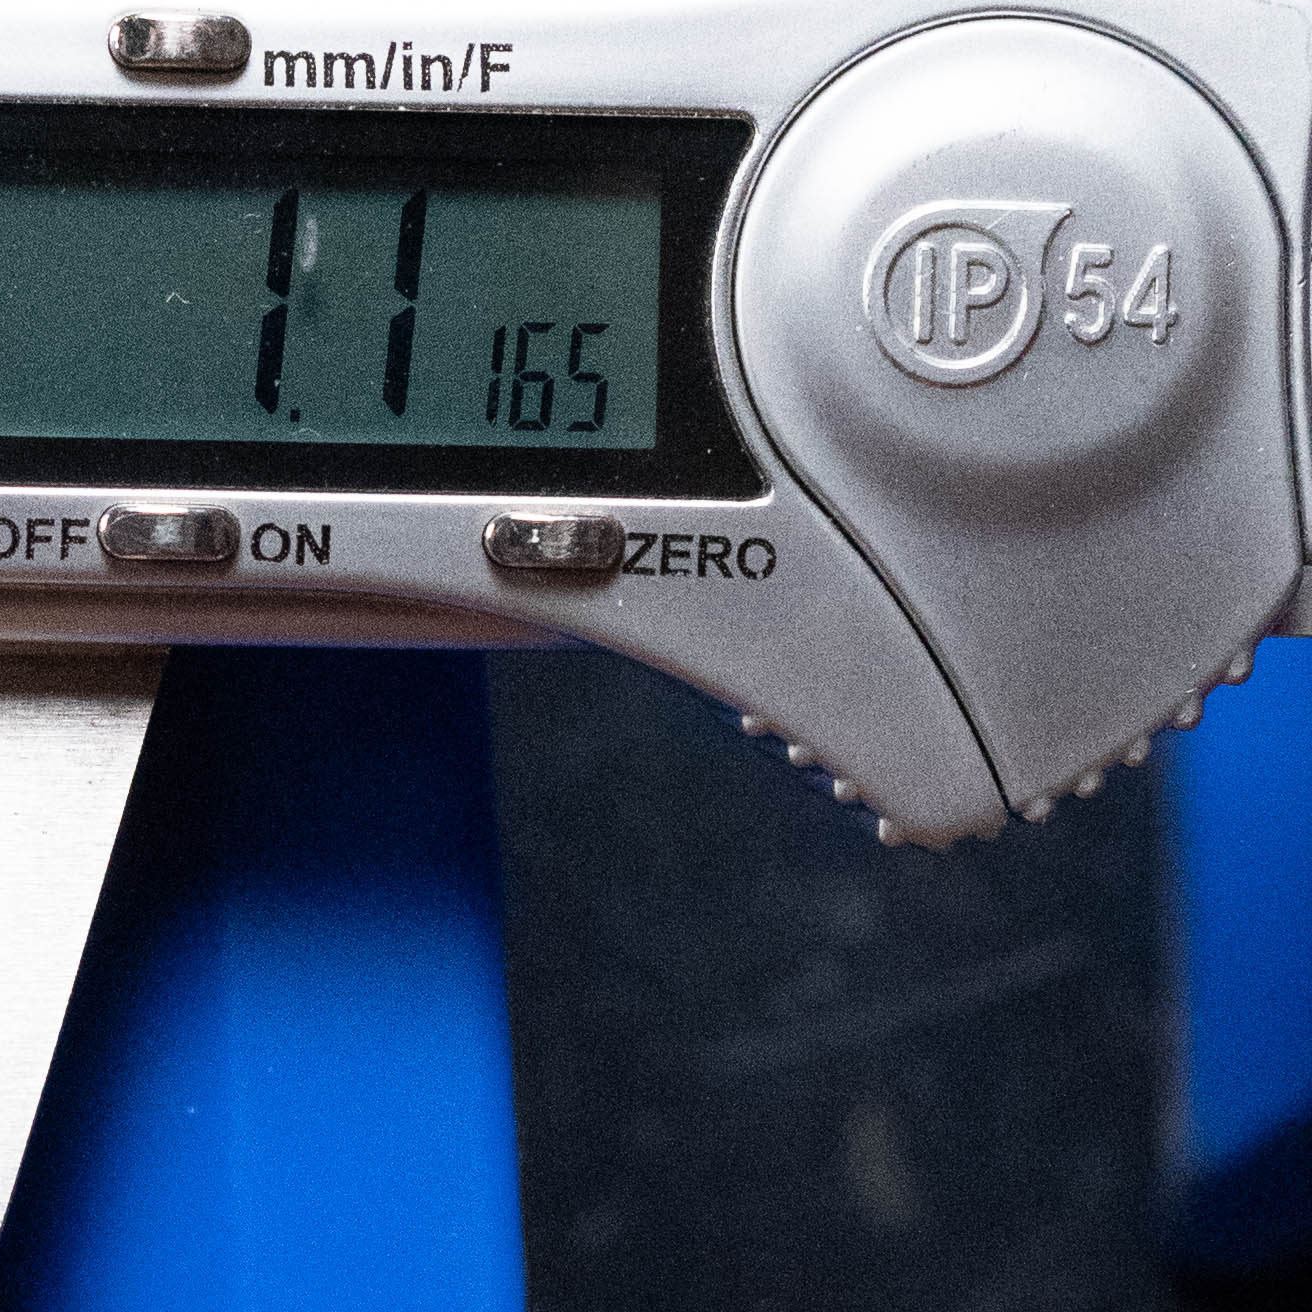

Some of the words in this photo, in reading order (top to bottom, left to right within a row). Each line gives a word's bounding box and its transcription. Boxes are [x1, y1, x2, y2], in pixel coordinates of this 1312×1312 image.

[262, 40, 514, 94] mm/in/F
[913, 241, 1010, 345] IP
[1064, 243, 1177, 346] 54
[250, 523, 332, 567] ON
[621, 531, 778, 581] ZERO
